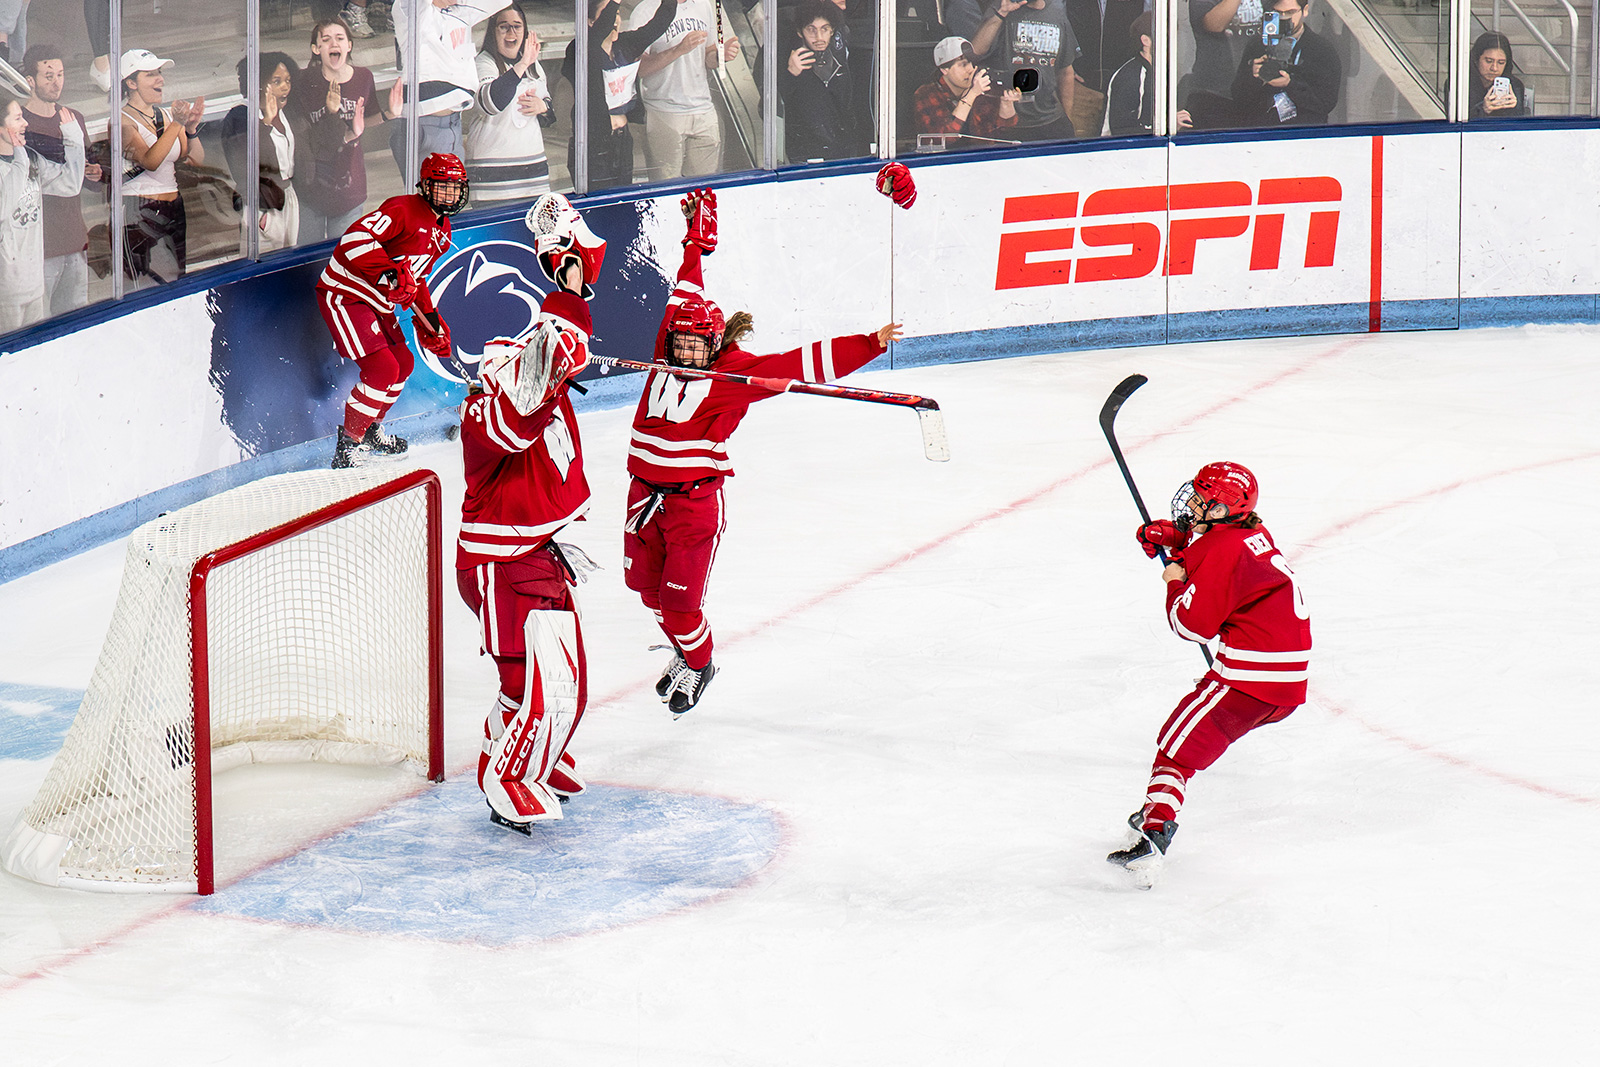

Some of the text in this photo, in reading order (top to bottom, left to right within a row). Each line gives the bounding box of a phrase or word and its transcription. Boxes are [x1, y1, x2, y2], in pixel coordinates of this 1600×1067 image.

[664, 18, 685, 43] PENN
[685, 17, 707, 32] STAT
[1016, 22, 1060, 39] FROZEN
[1032, 37, 1060, 54] FOUR
[361, 211, 393, 236] 20
[995, 176, 1343, 291] ESPN
[645, 371, 713, 424] W
[666, 581, 688, 591] CCM
[494, 717, 524, 776] CCM
[511, 717, 542, 777] CCM
